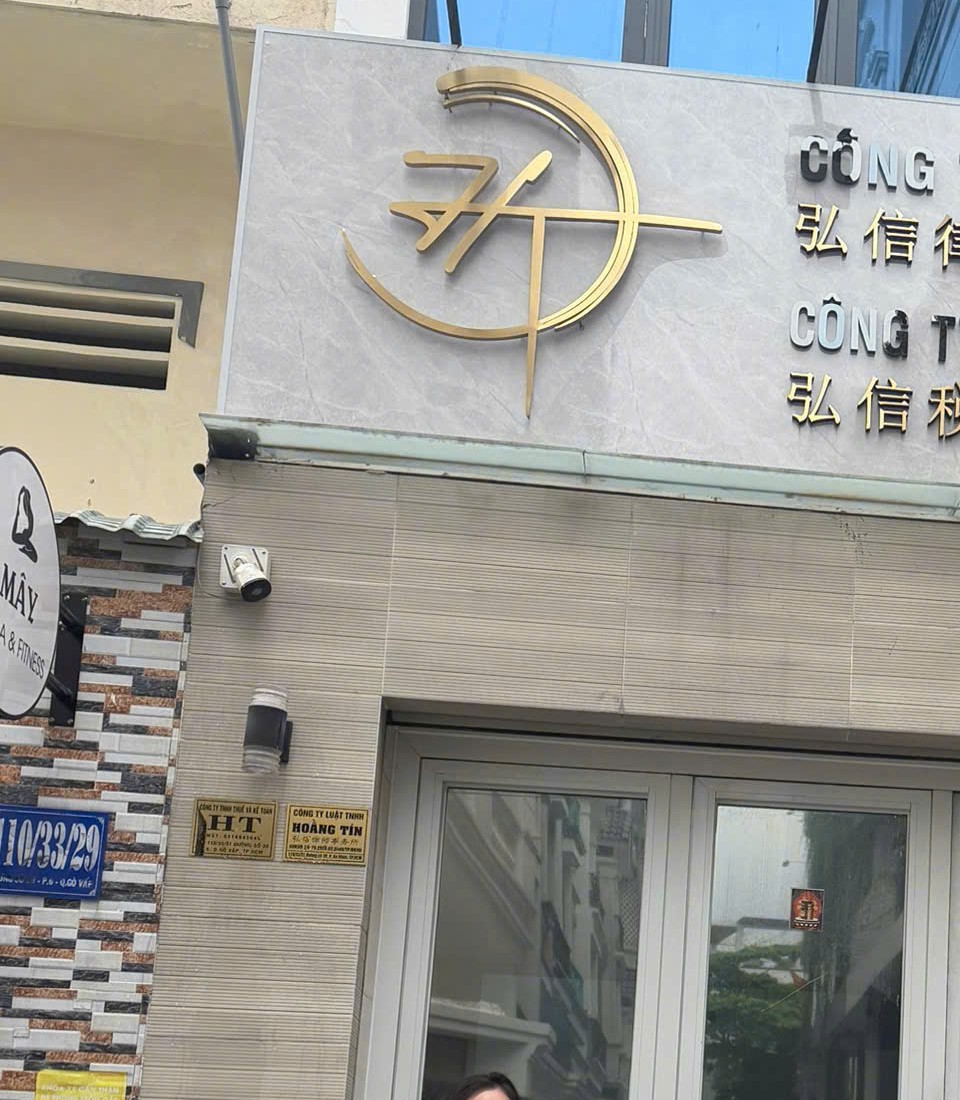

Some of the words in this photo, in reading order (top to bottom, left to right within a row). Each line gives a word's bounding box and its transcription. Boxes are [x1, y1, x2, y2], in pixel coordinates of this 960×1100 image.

[800, 128, 935, 196] CÔNG
[790, 292, 909, 359] CÔNG
[0, 562, 38, 624] MÂY
[8, 631, 15, 655] &
[17, 637, 45, 680] FITNESS
[208, 814, 261, 833] HT
[293, 809, 313, 817] CÔNG
[326, 810, 343, 820] LUẬT
[345, 812, 364, 820] TNHH
[340, 824, 362, 836] TÍN
[0, 818, 100, 872] 10/33/29
